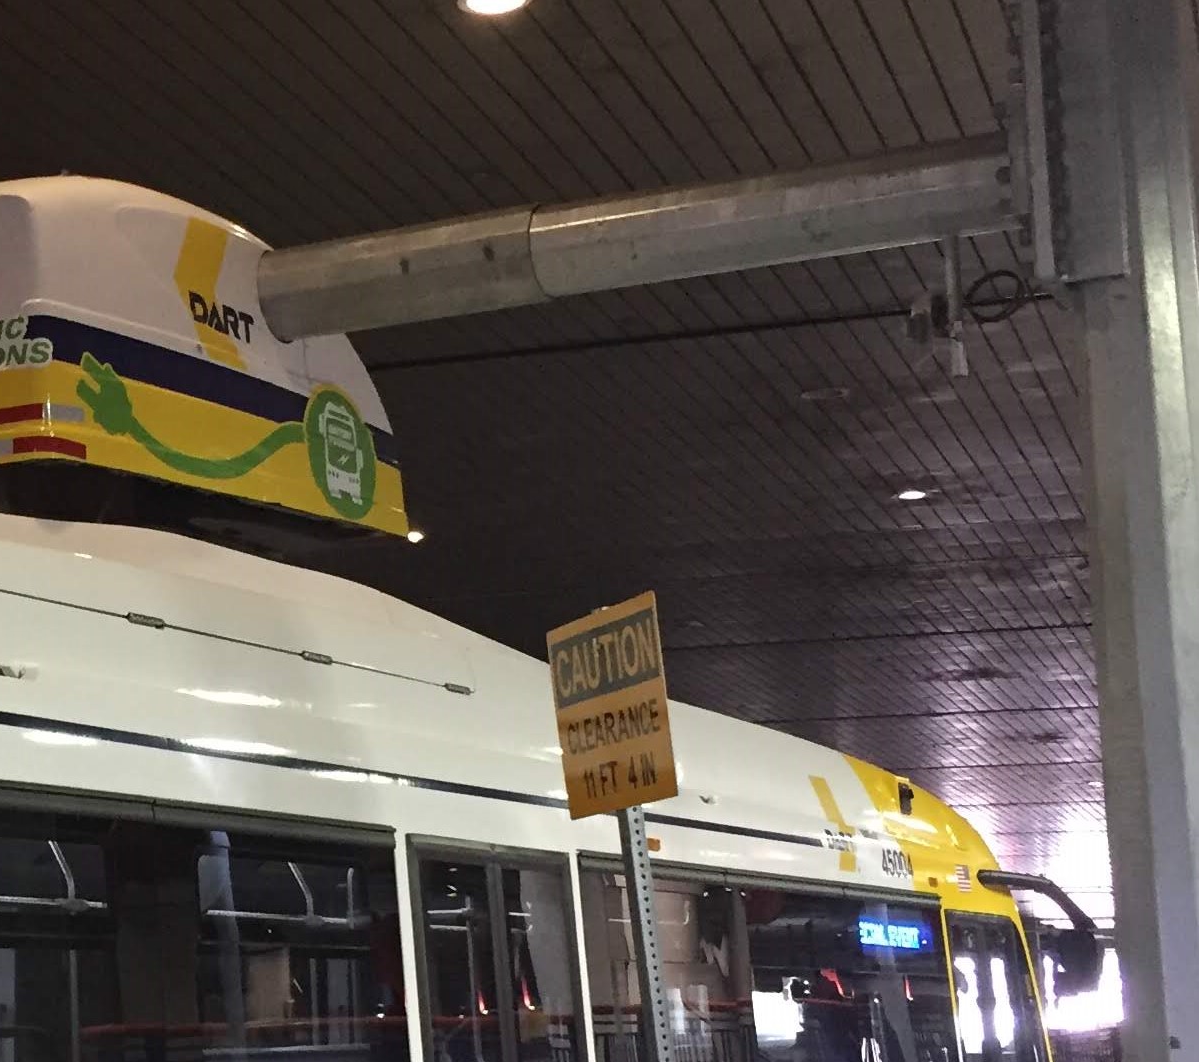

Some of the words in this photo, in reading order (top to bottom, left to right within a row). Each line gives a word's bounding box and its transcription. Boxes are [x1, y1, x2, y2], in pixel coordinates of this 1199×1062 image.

[188, 290, 254, 344] DART
[557, 617, 657, 697] CAUTION
[566, 699, 661, 756] CLEARANCE
